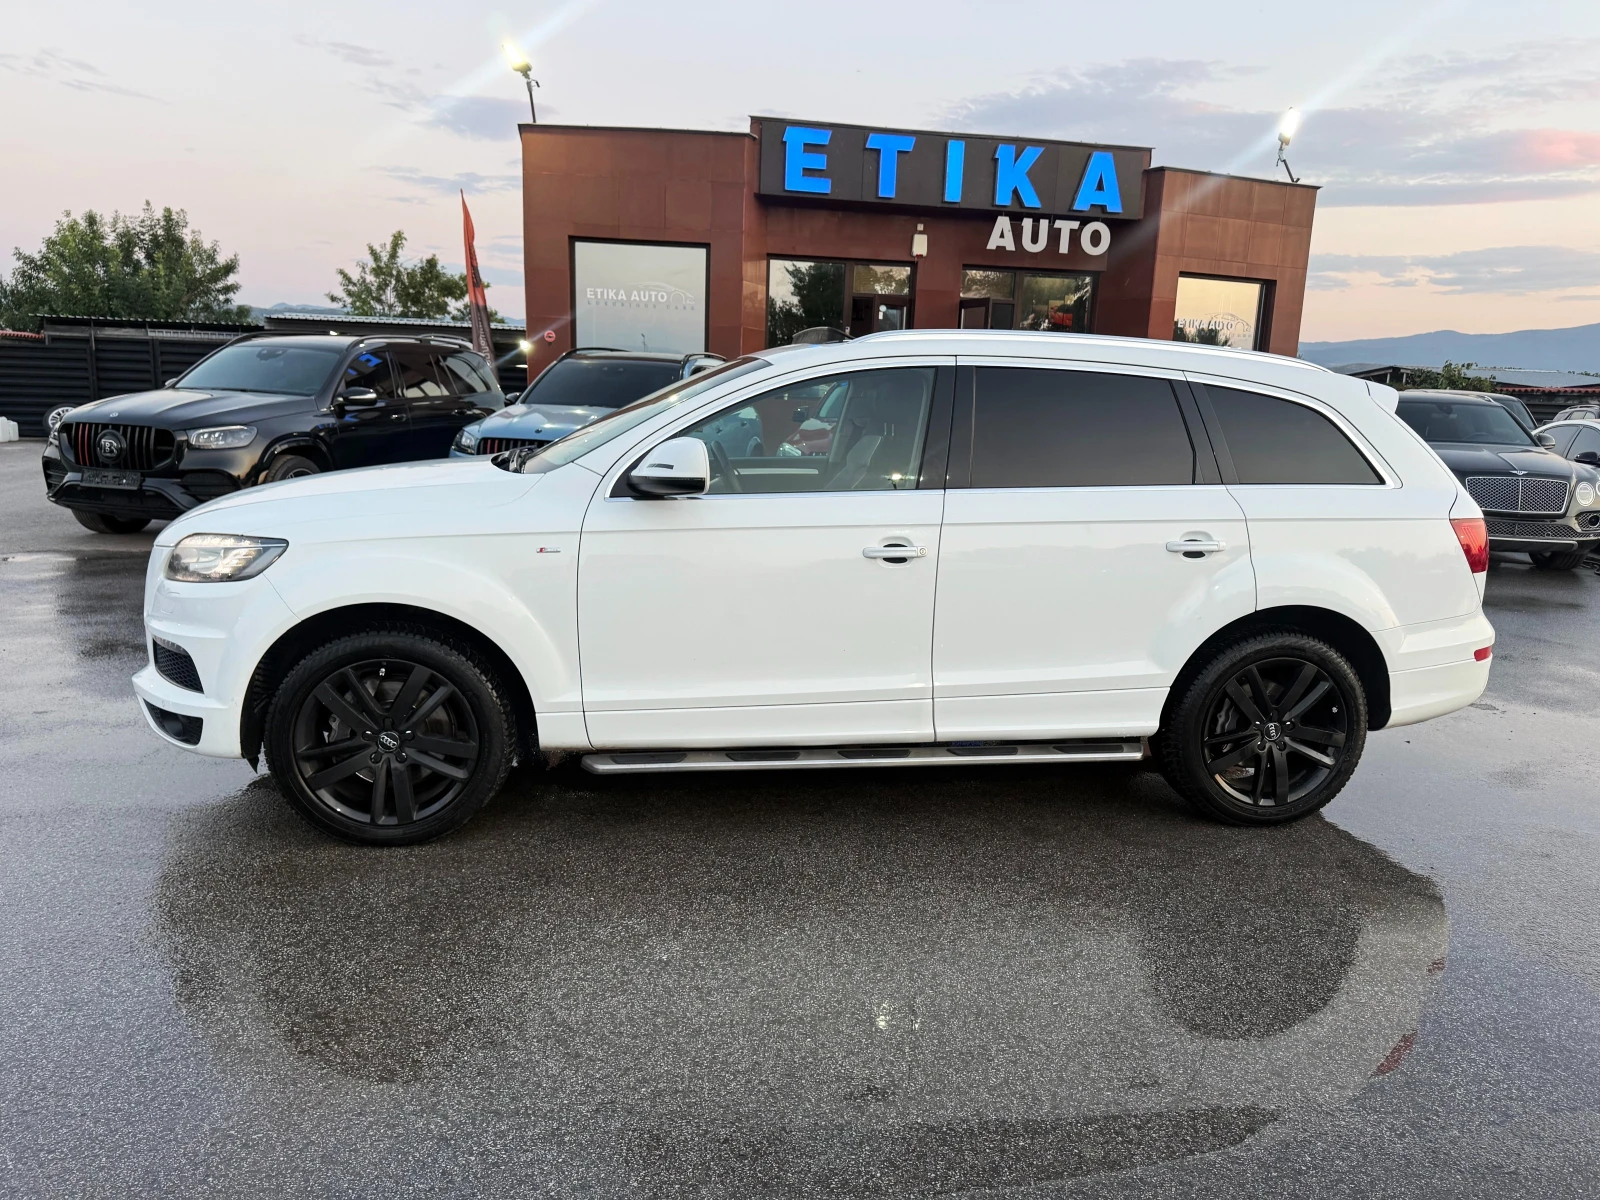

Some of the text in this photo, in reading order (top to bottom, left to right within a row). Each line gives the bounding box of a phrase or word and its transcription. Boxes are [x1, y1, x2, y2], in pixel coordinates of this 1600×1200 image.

[782, 126, 1124, 213] ETIKA
[986, 216, 1111, 256] AUTO
[586, 287, 667, 302] ETIKA AUTO
